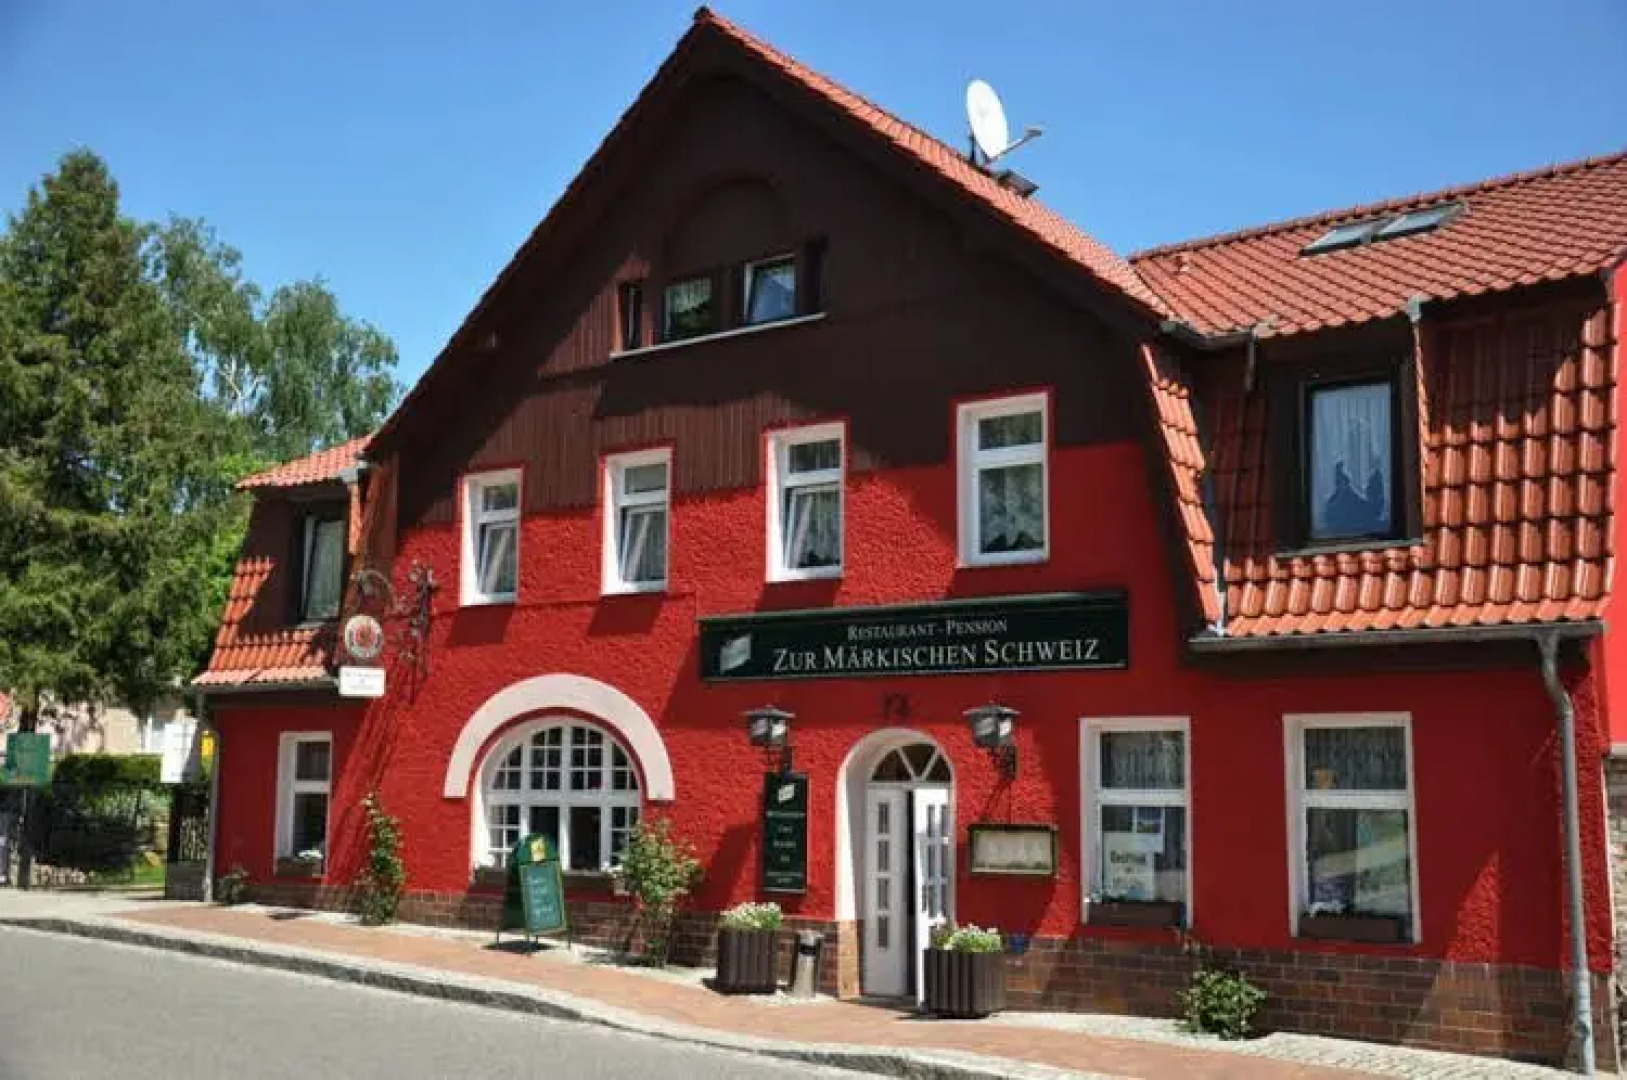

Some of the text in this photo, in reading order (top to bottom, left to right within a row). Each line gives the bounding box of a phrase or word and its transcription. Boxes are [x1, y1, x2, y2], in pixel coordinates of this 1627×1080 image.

[847, 622, 936, 641] RESTAURANT
[946, 619, 1008, 635] PENSION
[773, 639, 1100, 671] ZUR MÄRKISCHEN SCHWEIZ
